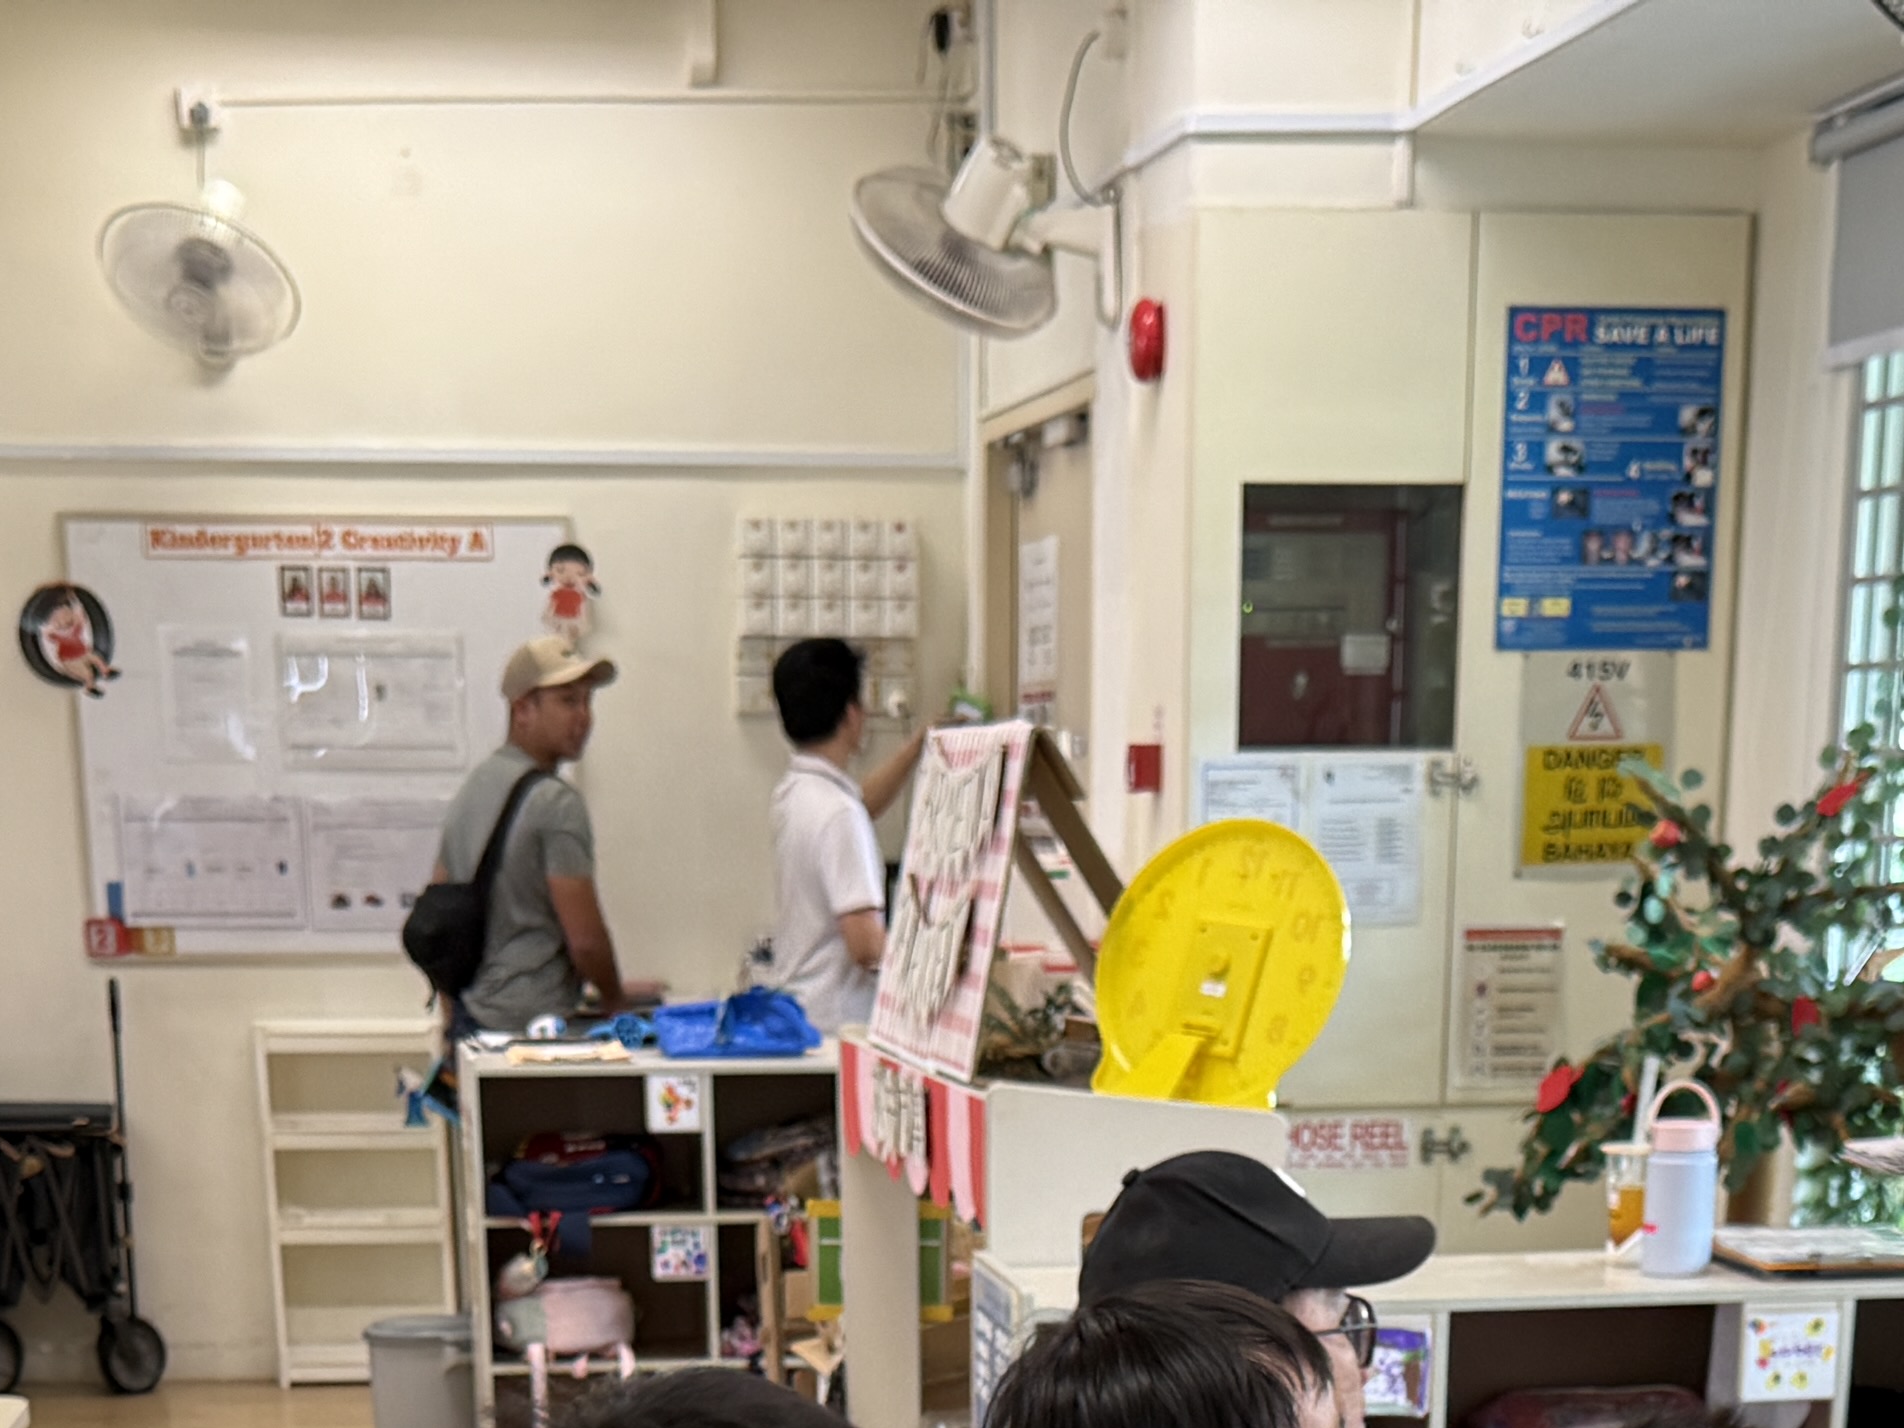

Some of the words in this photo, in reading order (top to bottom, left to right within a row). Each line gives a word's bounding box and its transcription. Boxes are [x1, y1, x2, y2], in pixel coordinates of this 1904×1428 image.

[1513, 313, 1589, 343] CPR
[1595, 326, 1649, 345] SAVE
[1673, 327, 1720, 346] LIFE
[1567, 660, 1631, 681] 415V
[1351, 1121, 1407, 1150] REEL
